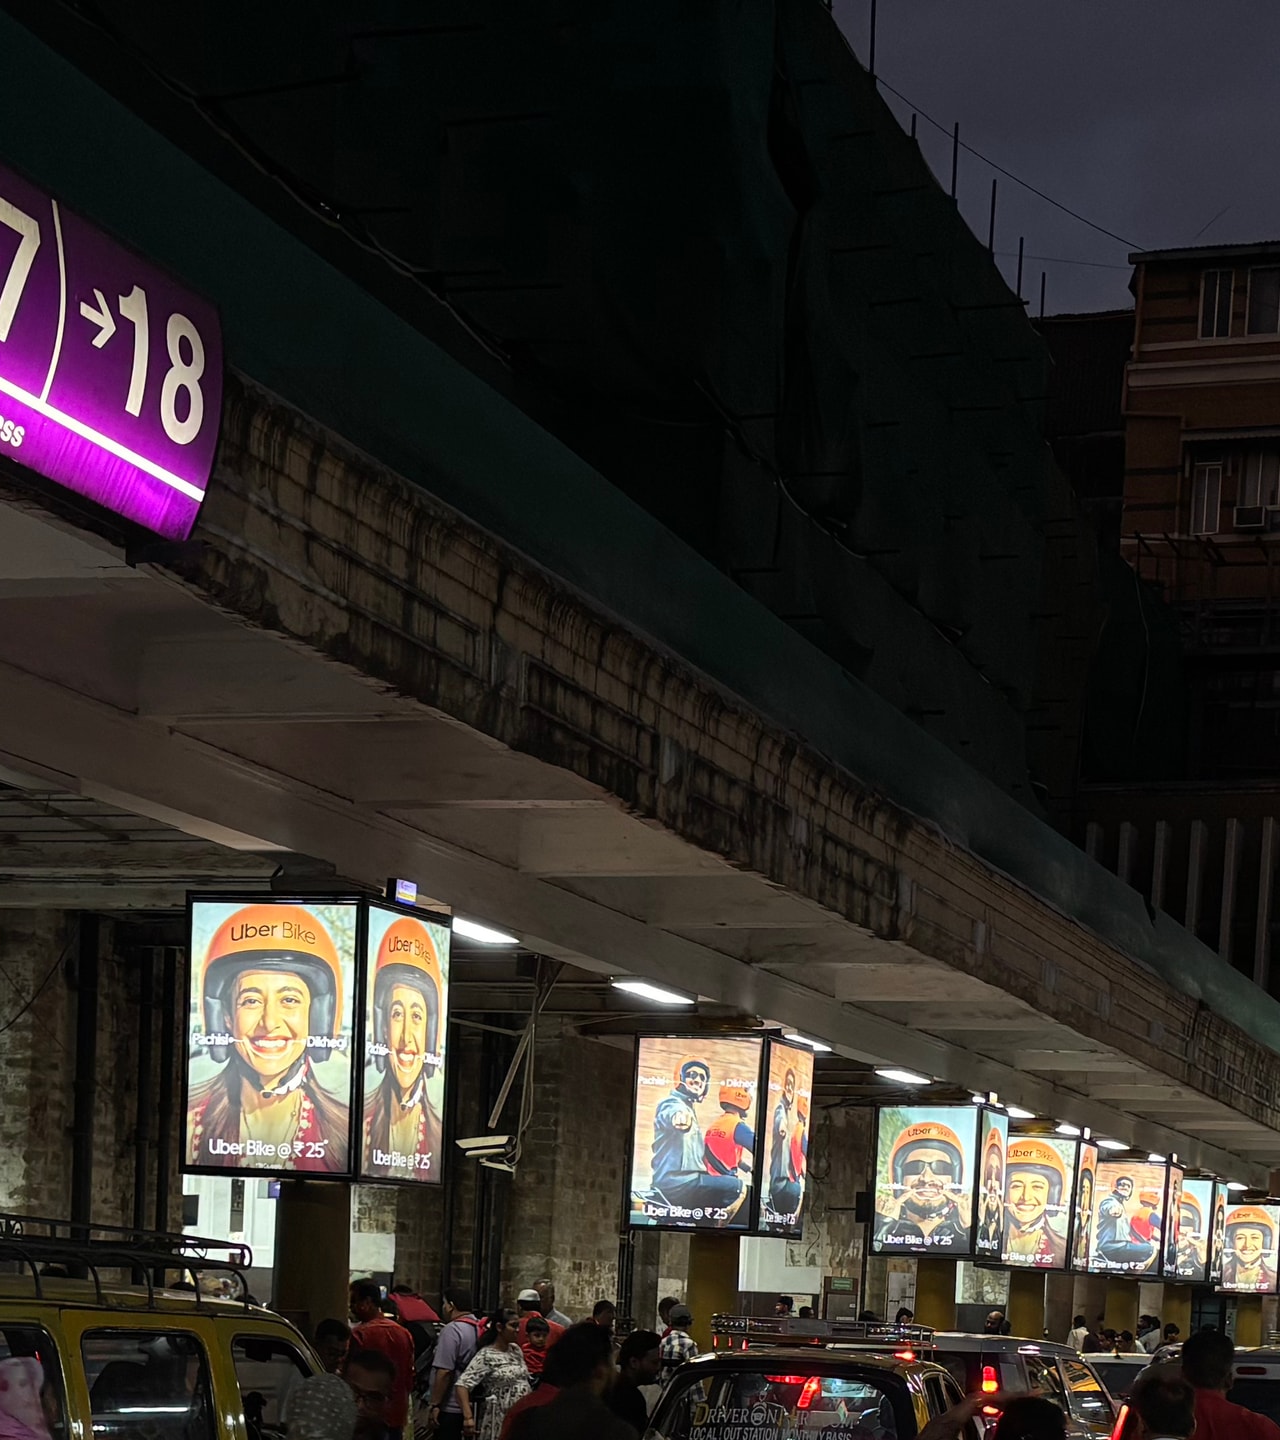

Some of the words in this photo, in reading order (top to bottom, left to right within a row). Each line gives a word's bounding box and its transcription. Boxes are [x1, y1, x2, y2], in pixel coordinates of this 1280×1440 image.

[119, 284, 205, 445] 18
[231, 923, 277, 942] Uber
[282, 921, 316, 944] Bike
[388, 937, 412, 953] Uber
[414, 939, 431, 965] Bike
[192, 1033, 229, 1046] Pachisi
[209, 1138, 245, 1156] Uber
[247, 1139, 275, 1156] Bike
[373, 1149, 391, 1166] Uber
[392, 1151, 407, 1167] Bike
[642, 1204, 669, 1219] Uber
[670, 1205, 691, 1219] Bike
[883, 1234, 904, 1245] Uber
